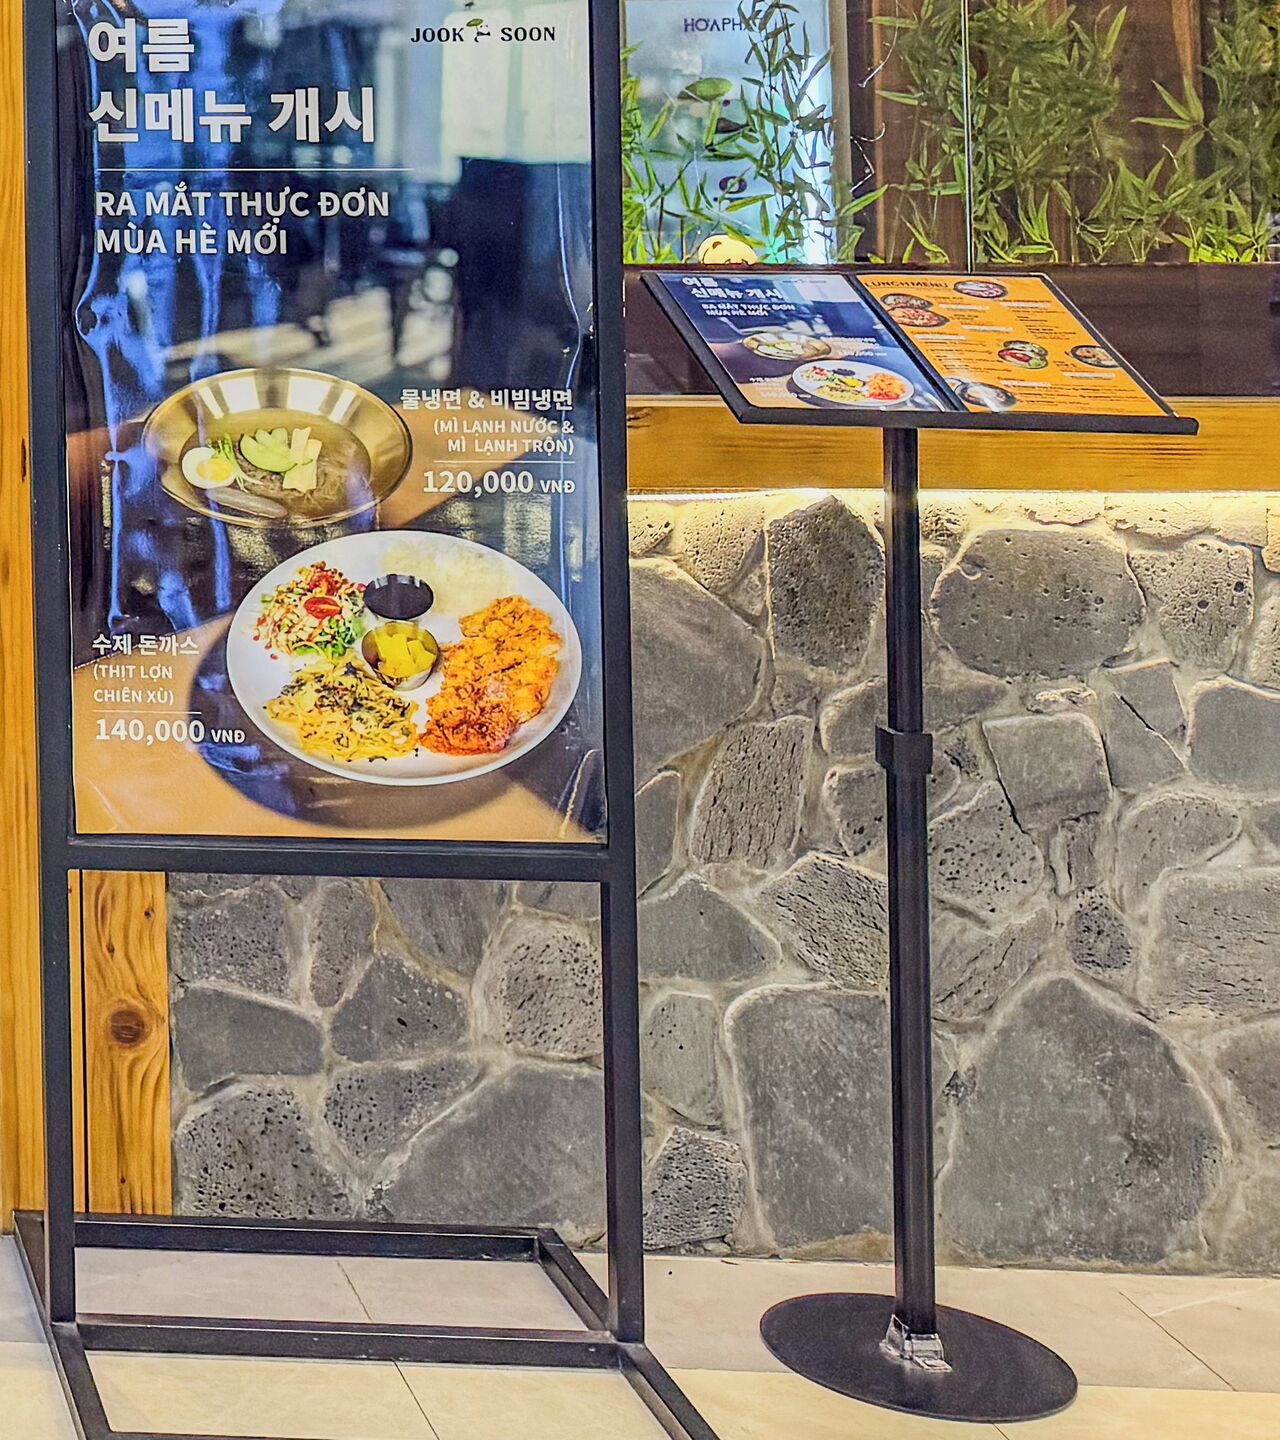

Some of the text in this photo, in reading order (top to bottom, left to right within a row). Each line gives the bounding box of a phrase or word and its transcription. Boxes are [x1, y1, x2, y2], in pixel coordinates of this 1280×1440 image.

[88, 18, 194, 73] 여름
[410, 26, 556, 43] JOOK SOON
[88, 87, 375, 143] 신메뉴 개시
[95, 181, 389, 224] RA MẮT THỰC ĐƠN
[96, 222, 287, 255] MÙA HÈ MỚI
[681, 276, 717, 288] 여름
[745, 287, 784, 300] 개시
[400, 388, 573, 410] 물냉면 & 비빔냉면
[433, 417, 574, 437] (MÌ LẠNH NƯỚC &
[448, 436, 574, 456] MÌ LẠNH TRỘN)
[423, 470, 576, 498] 120,000 VNĐ
[92, 633, 200, 656] 수제 돈까스
[93, 663, 173, 682] (THỊT LỢN
[93, 687, 174, 706] CHIÊN XÙ)
[95, 718, 246, 746] 140,000 VNĐ
